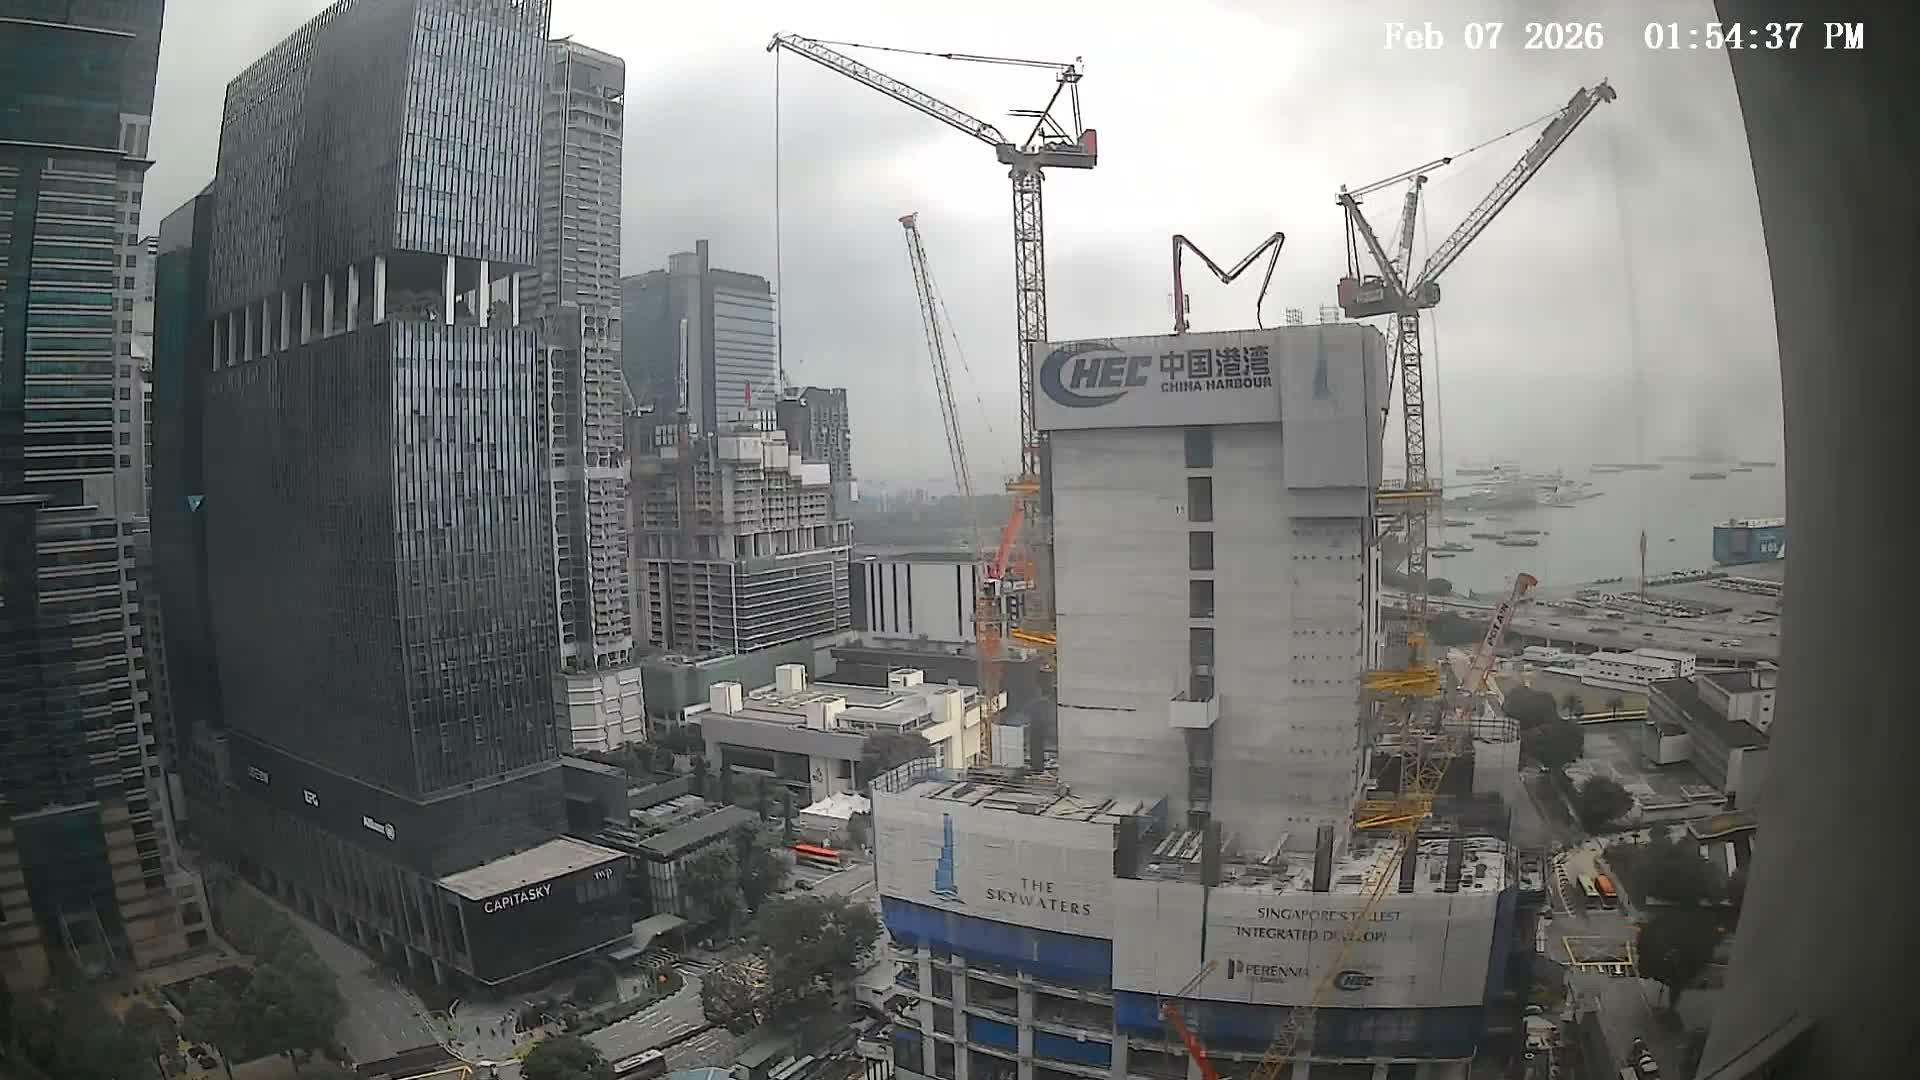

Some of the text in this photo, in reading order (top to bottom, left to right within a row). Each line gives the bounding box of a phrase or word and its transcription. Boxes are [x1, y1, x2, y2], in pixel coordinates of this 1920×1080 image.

[1159, 345, 1270, 380] 中国港湾
[1160, 377, 1272, 393] CHINA HARBOUR
[1021, 878, 1055, 893] THE
[484, 884, 552, 913] CAPITASKY
[986, 888, 1091, 915] SKYWATERS
[1236, 926, 1318, 943] INTEGRATED
